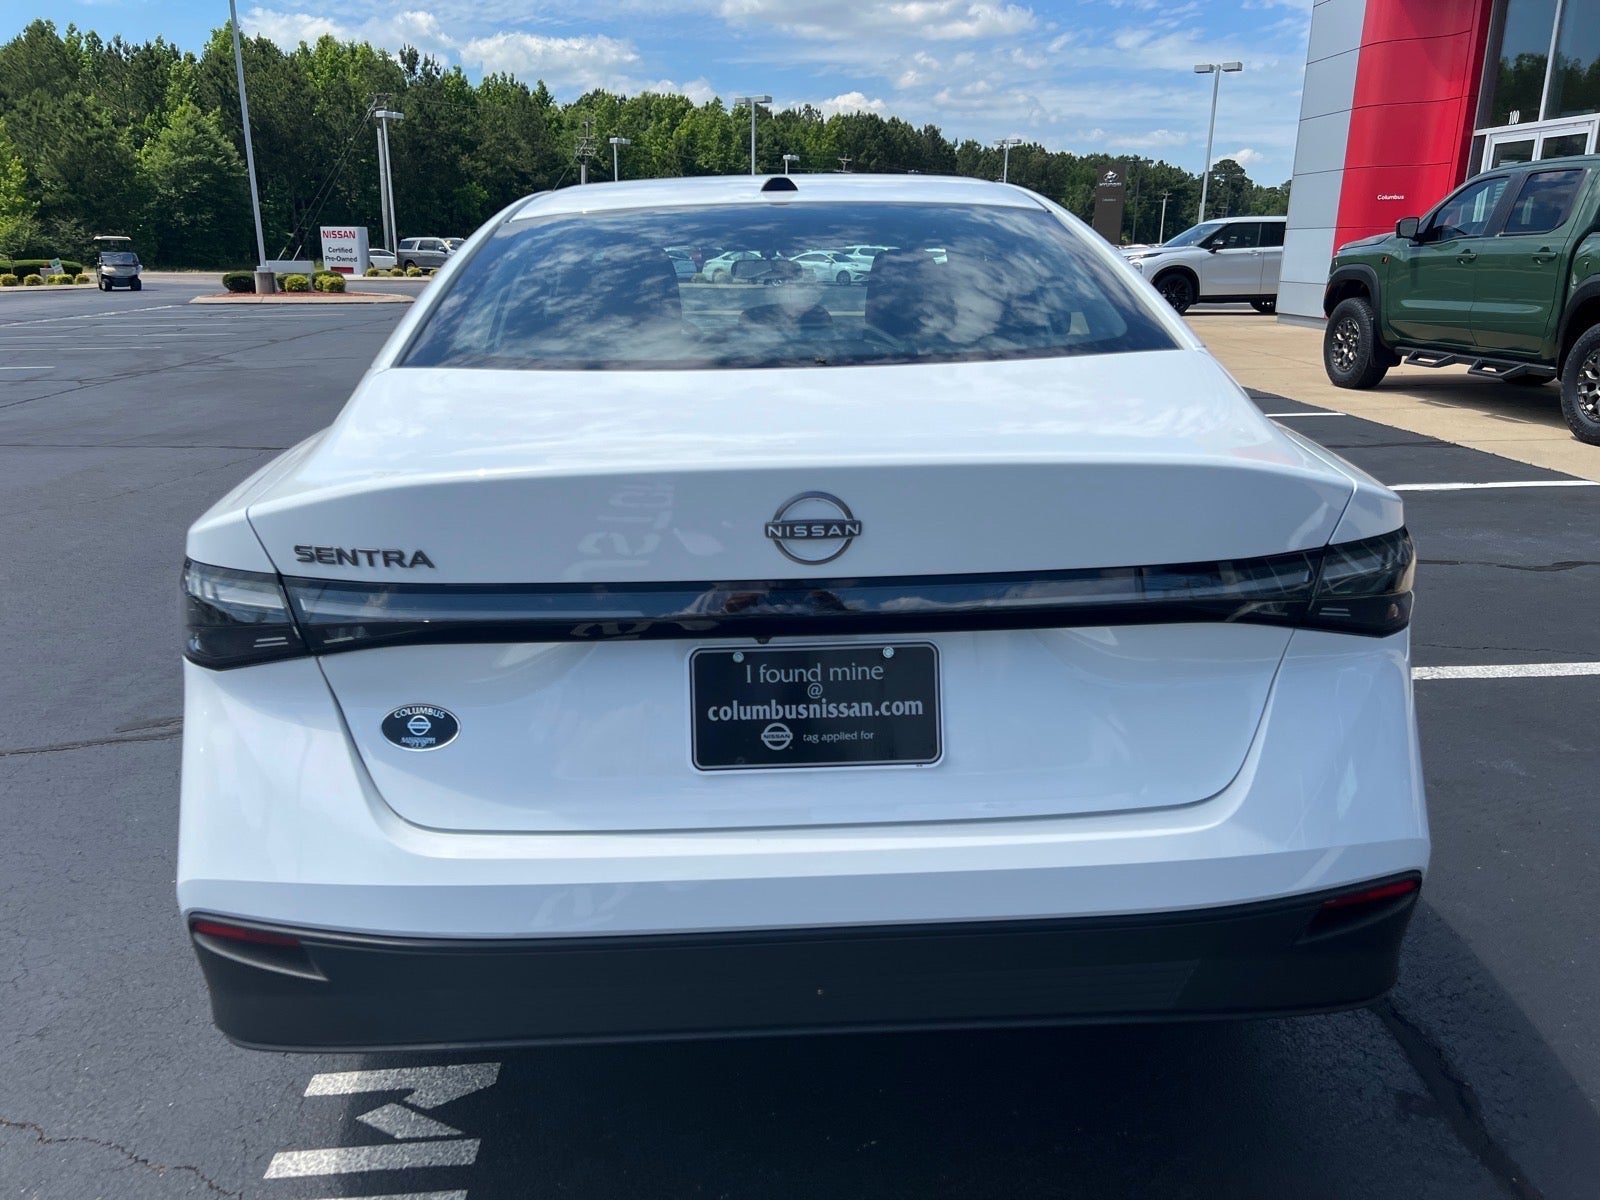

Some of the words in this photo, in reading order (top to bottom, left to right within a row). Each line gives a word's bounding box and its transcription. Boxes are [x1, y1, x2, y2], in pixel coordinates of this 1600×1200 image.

[1509, 110, 1520, 125] 100
[322, 230, 356, 239] NISSAN
[328, 246, 353, 254] Certified
[325, 255, 358, 263] Pre-Owned
[767, 524, 860, 537] NISSAN
[294, 544, 436, 569] SENTRA
[745, 664, 752, 684] I
[759, 662, 821, 684] found
[829, 662, 884, 681] mine
[807, 682, 823, 699] @
[394, 707, 446, 719] COLUMBUS
[707, 698, 924, 722] columbusnissan.com
[803, 734, 820, 744] tag
[821, 731, 858, 743] applied
[860, 730, 875, 740] for
